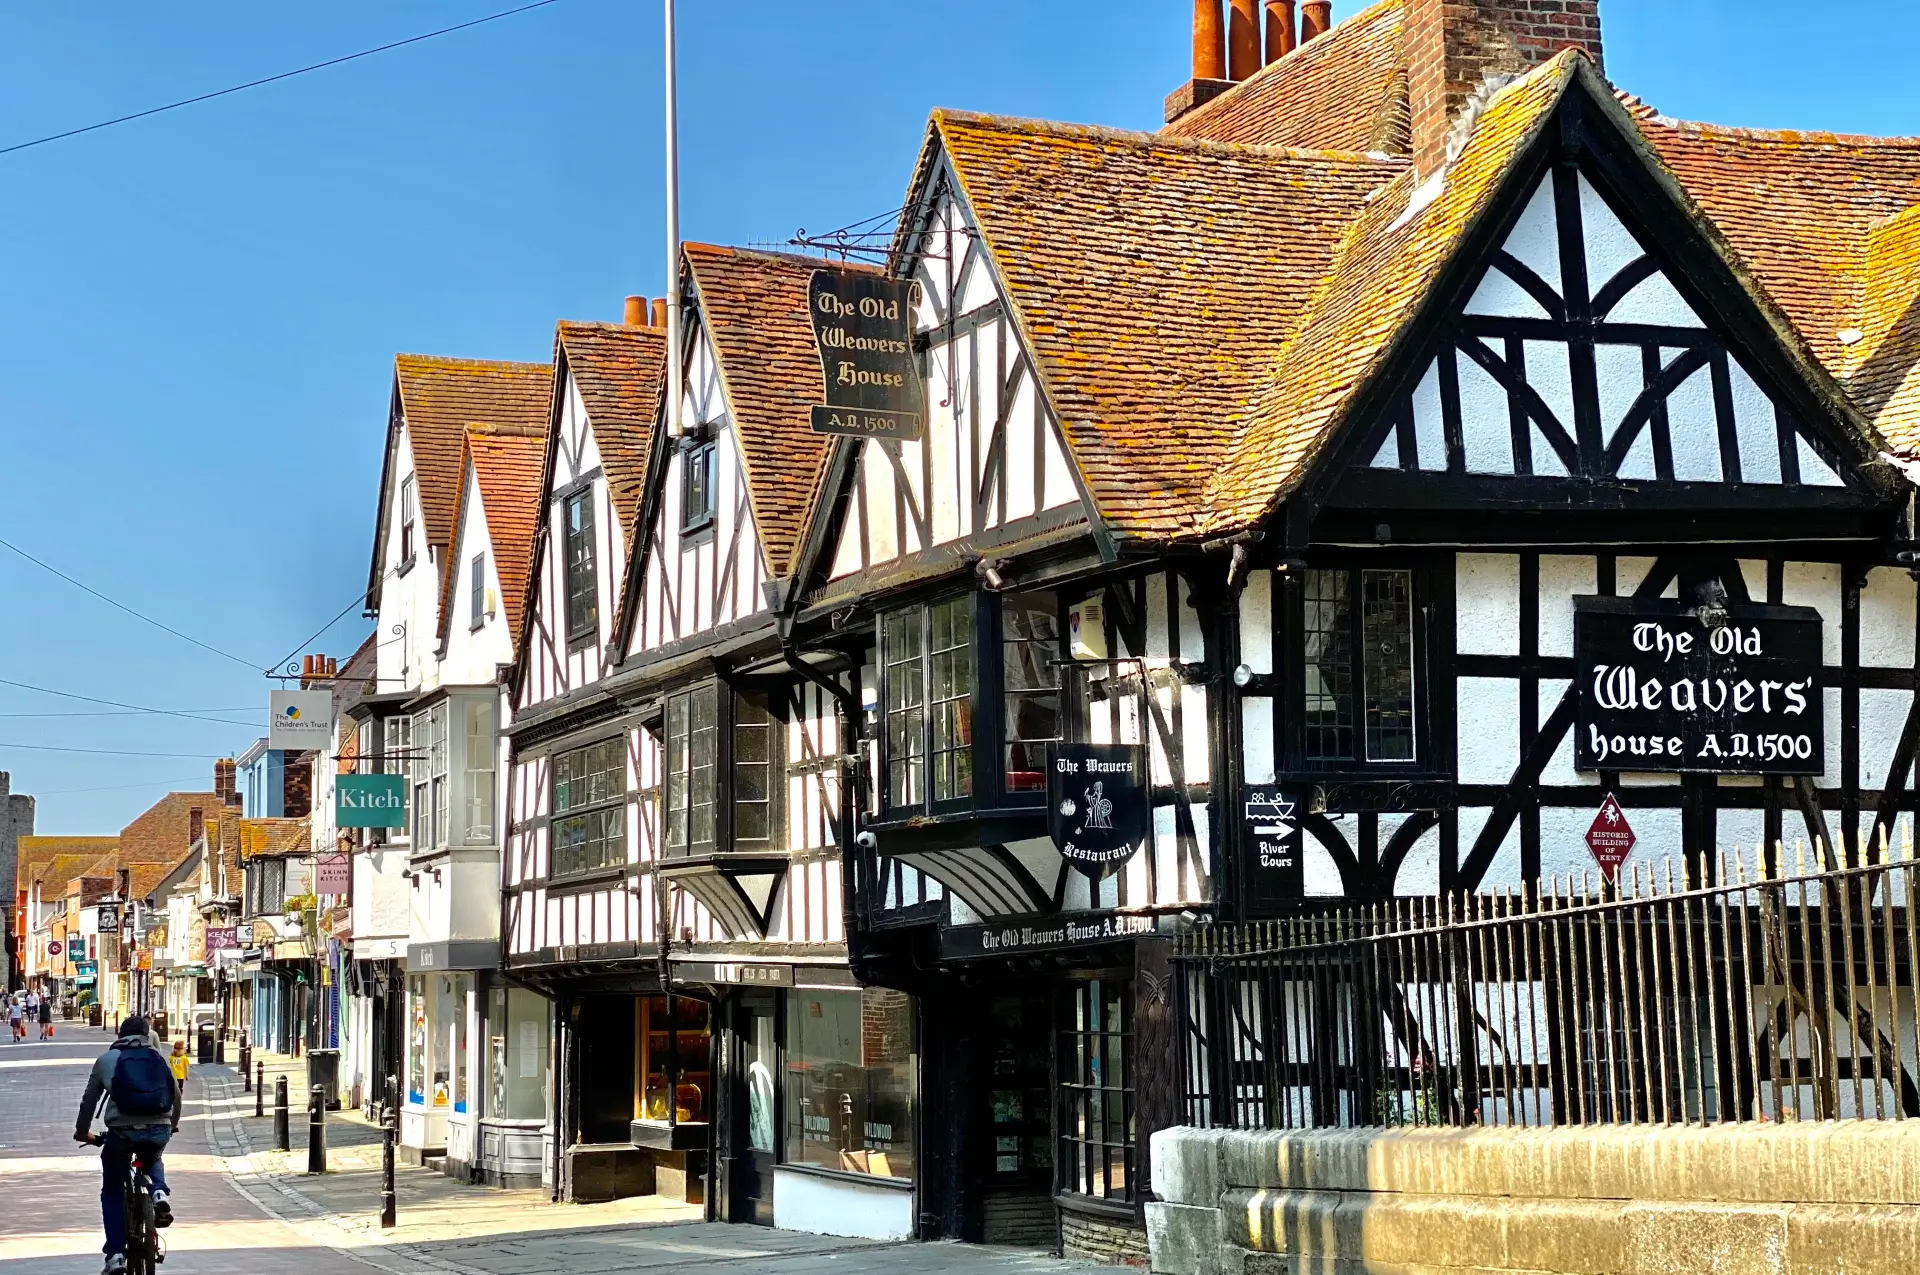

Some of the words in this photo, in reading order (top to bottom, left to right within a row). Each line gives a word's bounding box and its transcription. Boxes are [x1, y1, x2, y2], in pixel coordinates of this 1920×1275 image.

[818, 292, 856, 319] The
[859, 296, 899, 321] Old
[821, 326, 907, 354] Weavers
[836, 361, 904, 387] House
[828, 414, 861, 429] A.D.
[864, 416, 896, 432] 1500
[1633, 622, 1694, 662] The
[1710, 626, 1763, 656] Old
[1593, 665, 1812, 715] Weavers'
[274, 720, 309, 728] Children's
[1589, 723, 1684, 762] house
[1056, 758, 1079, 776] The
[1085, 758, 1133, 773] Weavers
[338, 788, 401, 809] Kitch
[1592, 831, 1629, 839] HISTORIC
[1592, 839, 1629, 847] BUILDING
[1062, 841, 1132, 862] Restaurant
[1259, 841, 1290, 854] River
[1260, 854, 1292, 867] Tours
[207, 930, 236, 938] KENT
[982, 930, 1000, 951] The
[1001, 928, 1019, 948] Old
[1021, 927, 1064, 946] Weavers
[1066, 921, 1100, 944] House
[389, 941, 397, 955] 5
